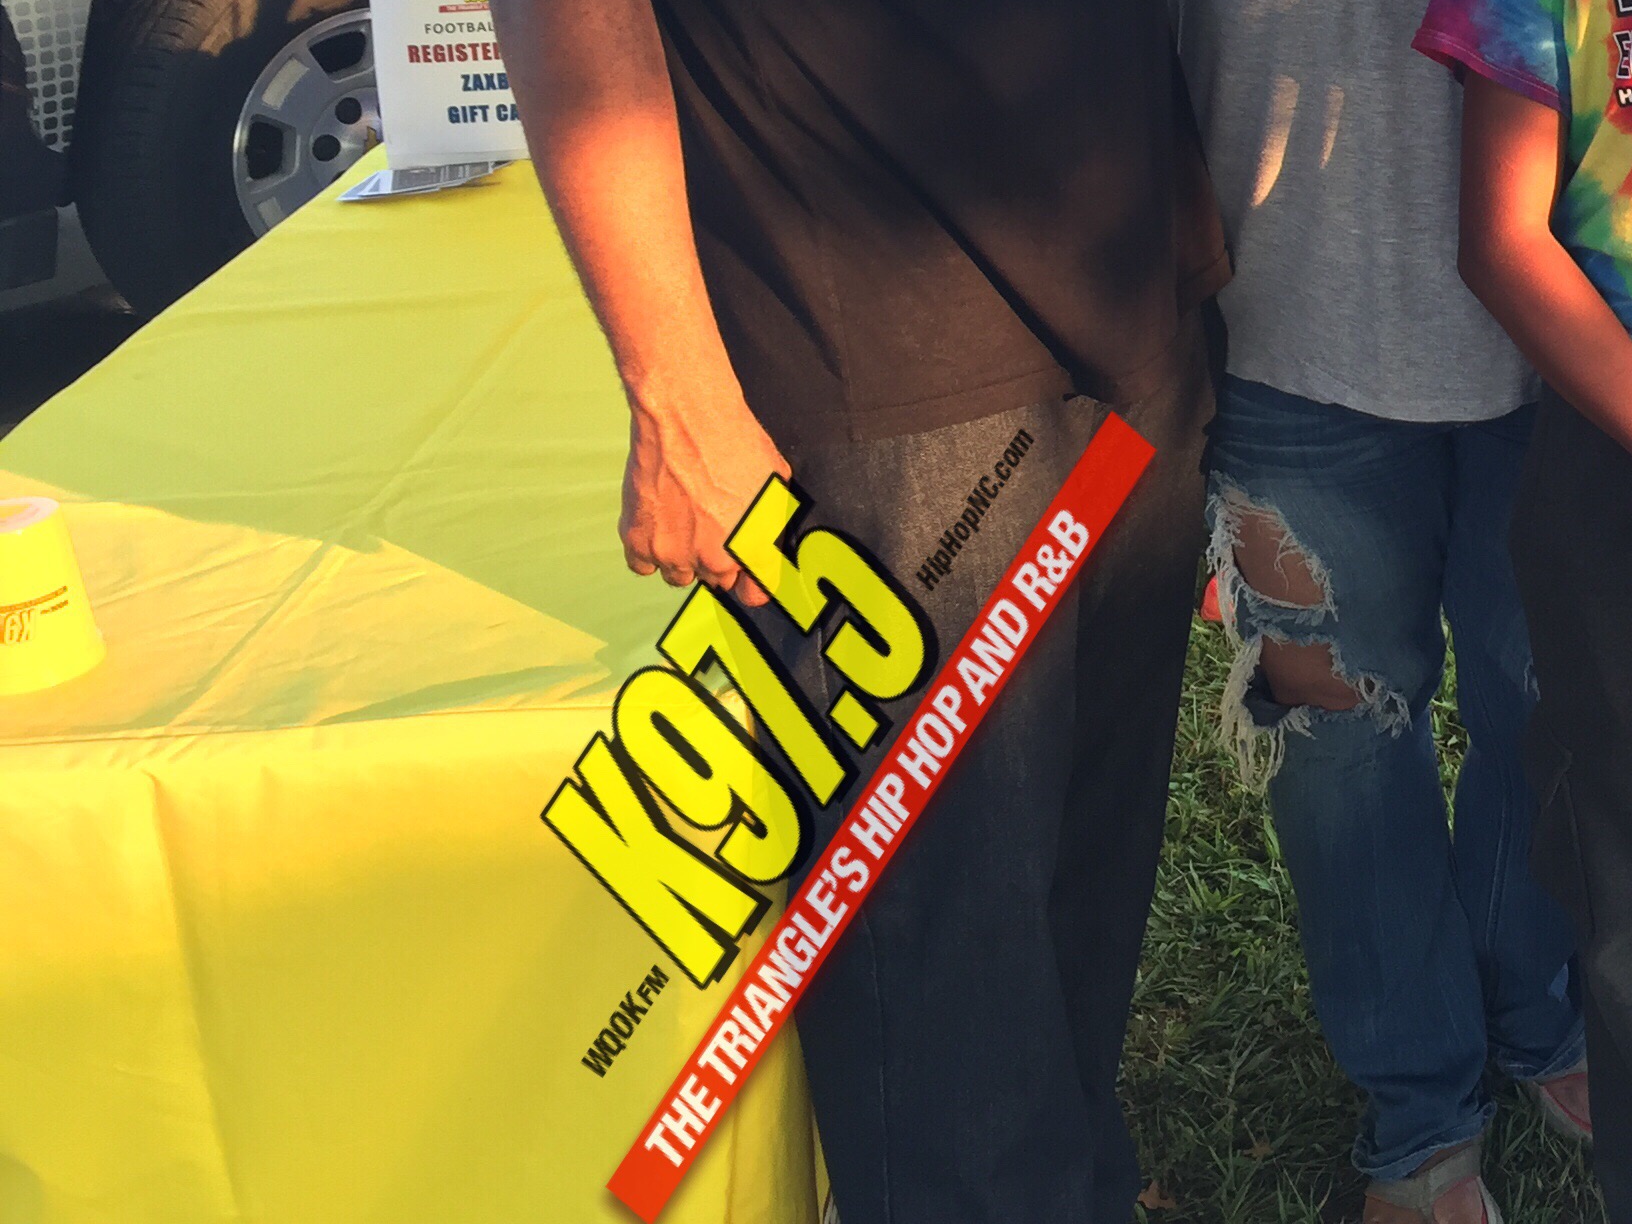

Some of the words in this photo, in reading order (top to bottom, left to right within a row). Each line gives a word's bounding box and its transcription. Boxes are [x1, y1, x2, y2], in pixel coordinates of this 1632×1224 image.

[424, 21, 494, 34] FOOTBAL
[460, 72, 510, 92] ZAXB
[447, 105, 489, 124] GIFT
[495, 103, 520, 122] CA
